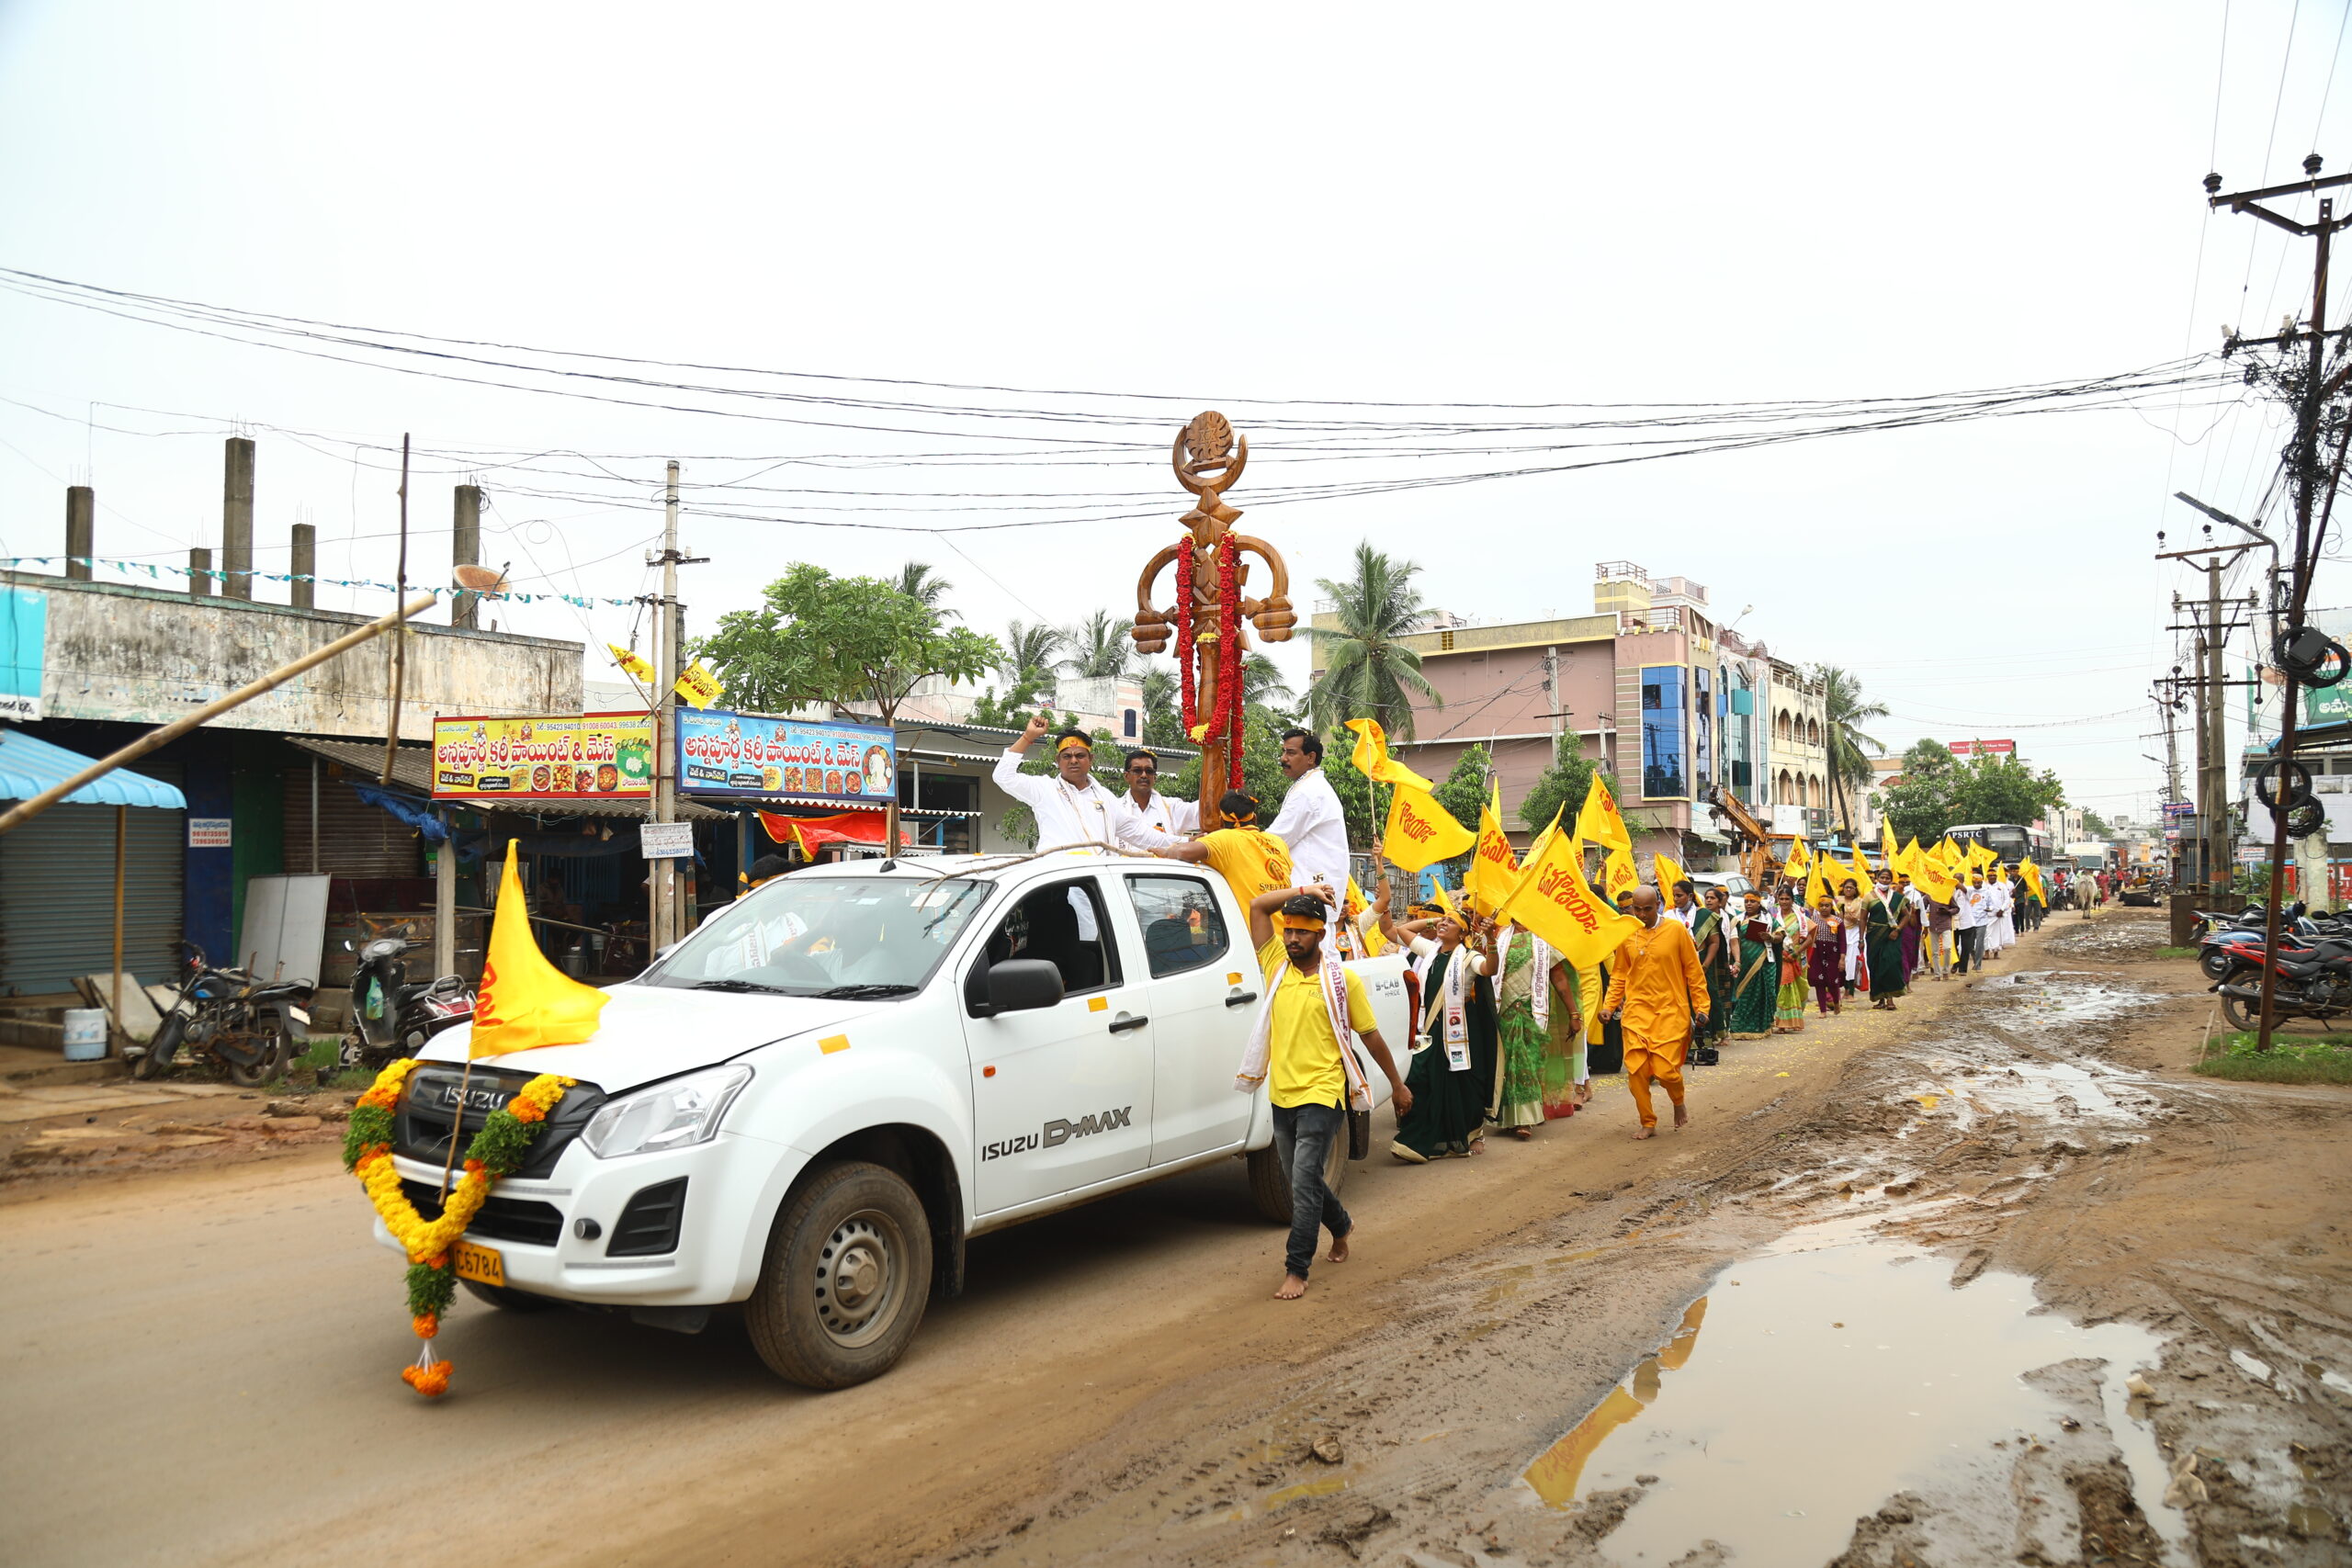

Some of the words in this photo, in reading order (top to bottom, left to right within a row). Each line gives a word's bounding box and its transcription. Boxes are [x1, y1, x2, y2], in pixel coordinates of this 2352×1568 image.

[437, 740, 487, 773] అన్నపూర్ణ
[512, 736, 570, 761] పాయింట్
[572, 741, 583, 761] &
[586, 736, 614, 761] మెస్
[685, 735, 741, 769] అన్నపూర్ణ
[766, 740, 821, 764] పాయింట్
[824, 748, 834, 765] &
[837, 745, 860, 767] మెస్
[445, 1086, 505, 1110] ISUZU
[982, 1133, 1038, 1162] ISUZU
[1043, 1106, 1132, 1149] D-MAX
